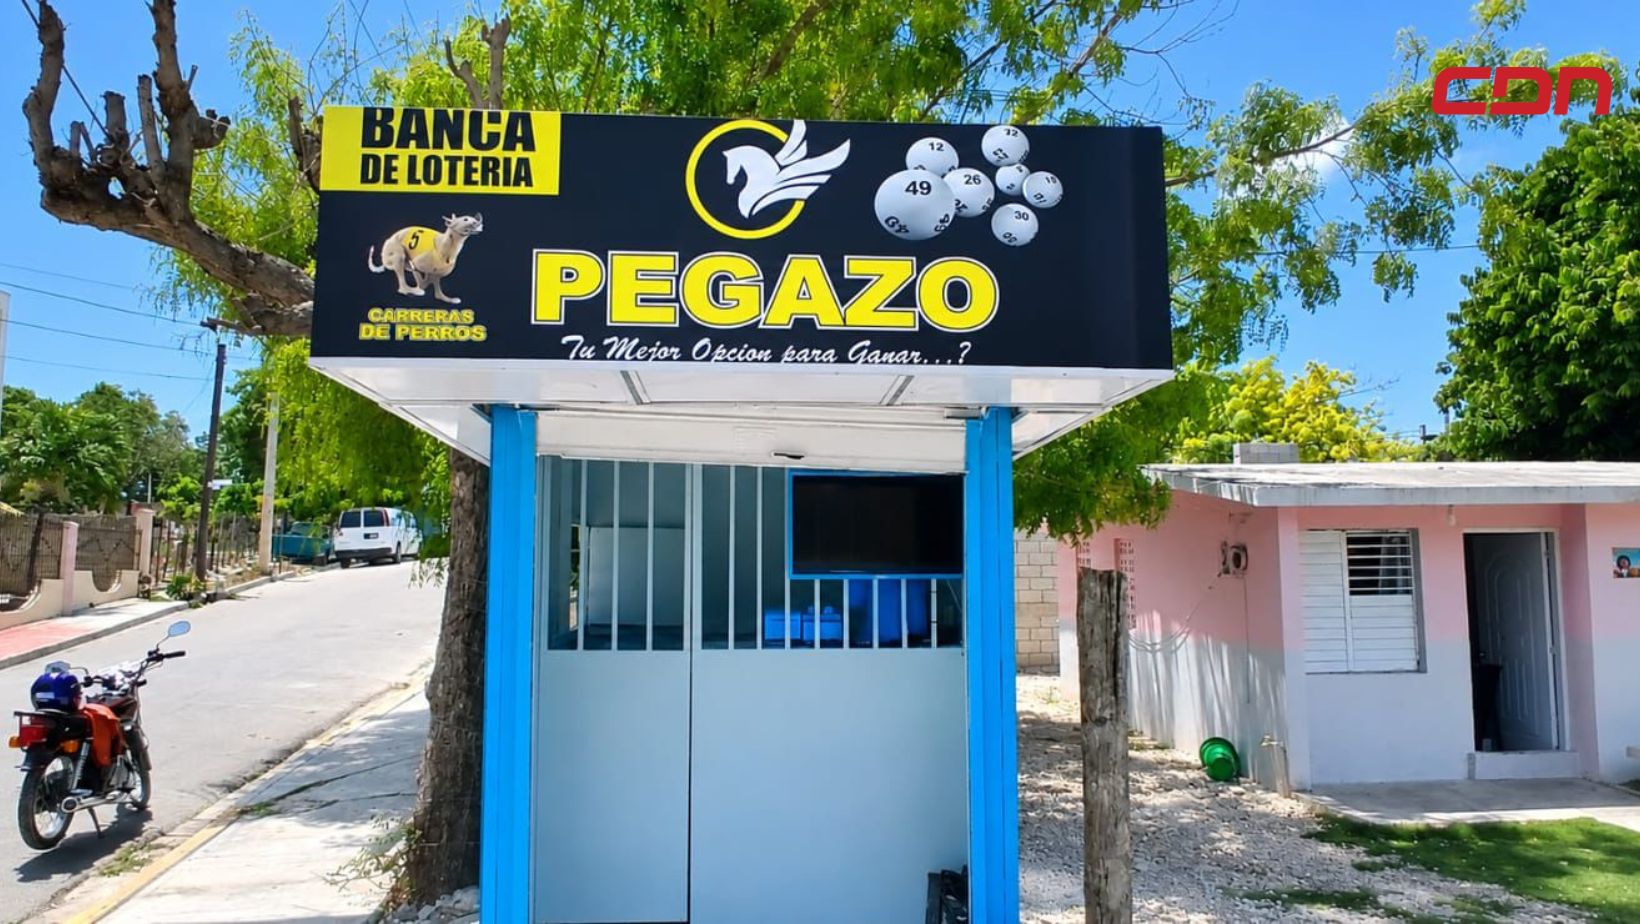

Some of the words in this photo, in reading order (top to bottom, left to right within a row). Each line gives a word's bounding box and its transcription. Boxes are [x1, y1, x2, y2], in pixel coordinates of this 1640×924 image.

[361, 107, 536, 151] BANCA
[928, 141, 945, 152] 12
[360, 154, 399, 185] DE
[407, 154, 533, 187] LOTERIA
[963, 173, 982, 186] 26
[905, 180, 932, 196] 49
[1014, 210, 1030, 221] 30
[408, 229, 425, 250] 5
[530, 248, 1000, 332] PEGAZO
[367, 307, 475, 324] CARRERAS
[359, 322, 391, 341] DE
[395, 323, 488, 342] PERROS
[561, 335, 597, 360] Tu
[602, 336, 682, 361] Mejor
[692, 337, 773, 363] Opcion
[780, 345, 839, 363] para
